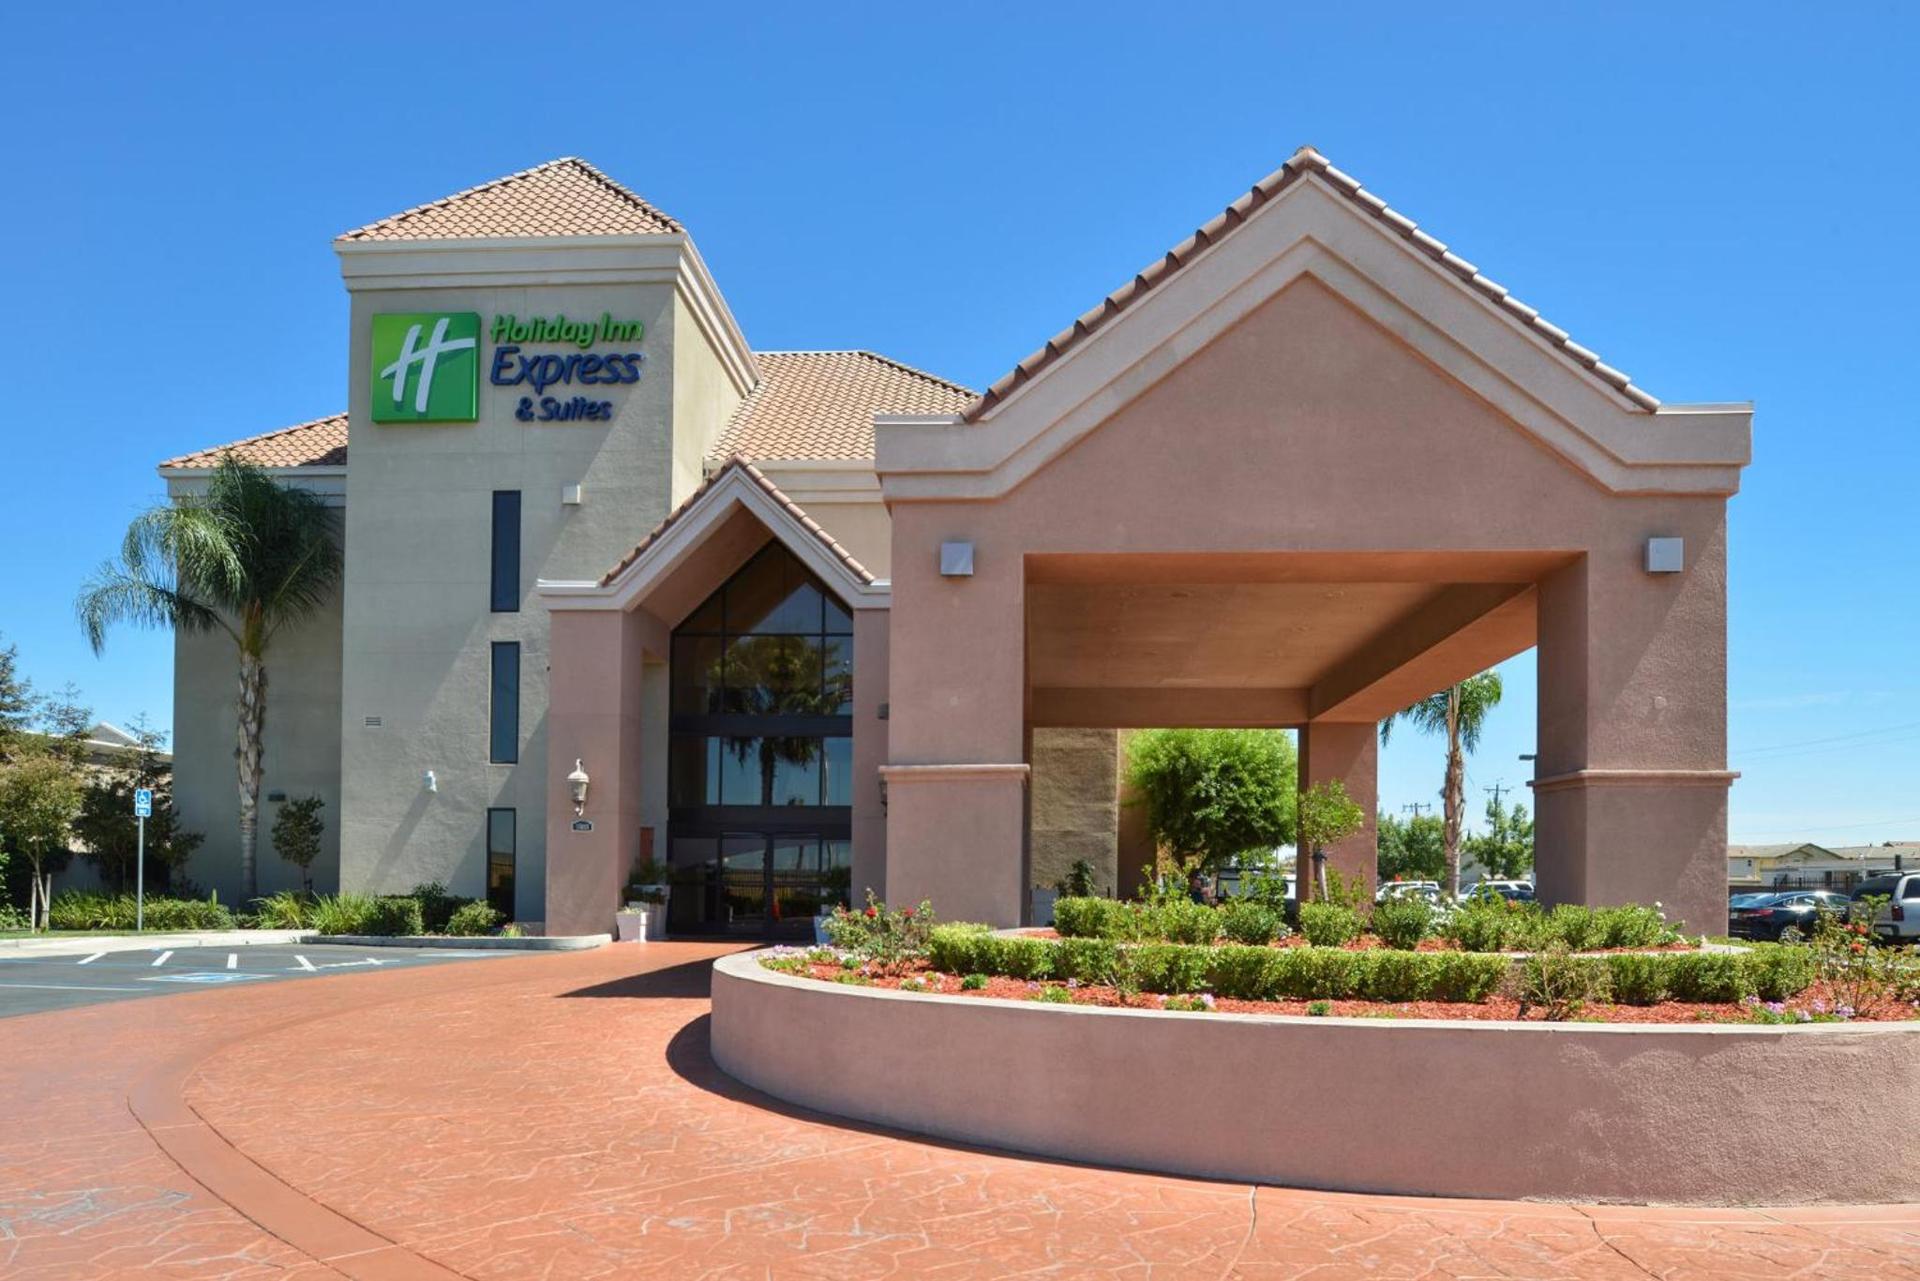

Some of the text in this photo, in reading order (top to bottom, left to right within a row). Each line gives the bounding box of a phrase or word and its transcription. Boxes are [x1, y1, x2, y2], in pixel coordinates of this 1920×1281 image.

[490, 311, 643, 349] Holiday Inn
[380, 317, 476, 413] H
[490, 346, 643, 395] Express
[515, 396, 613, 422] & Suites
